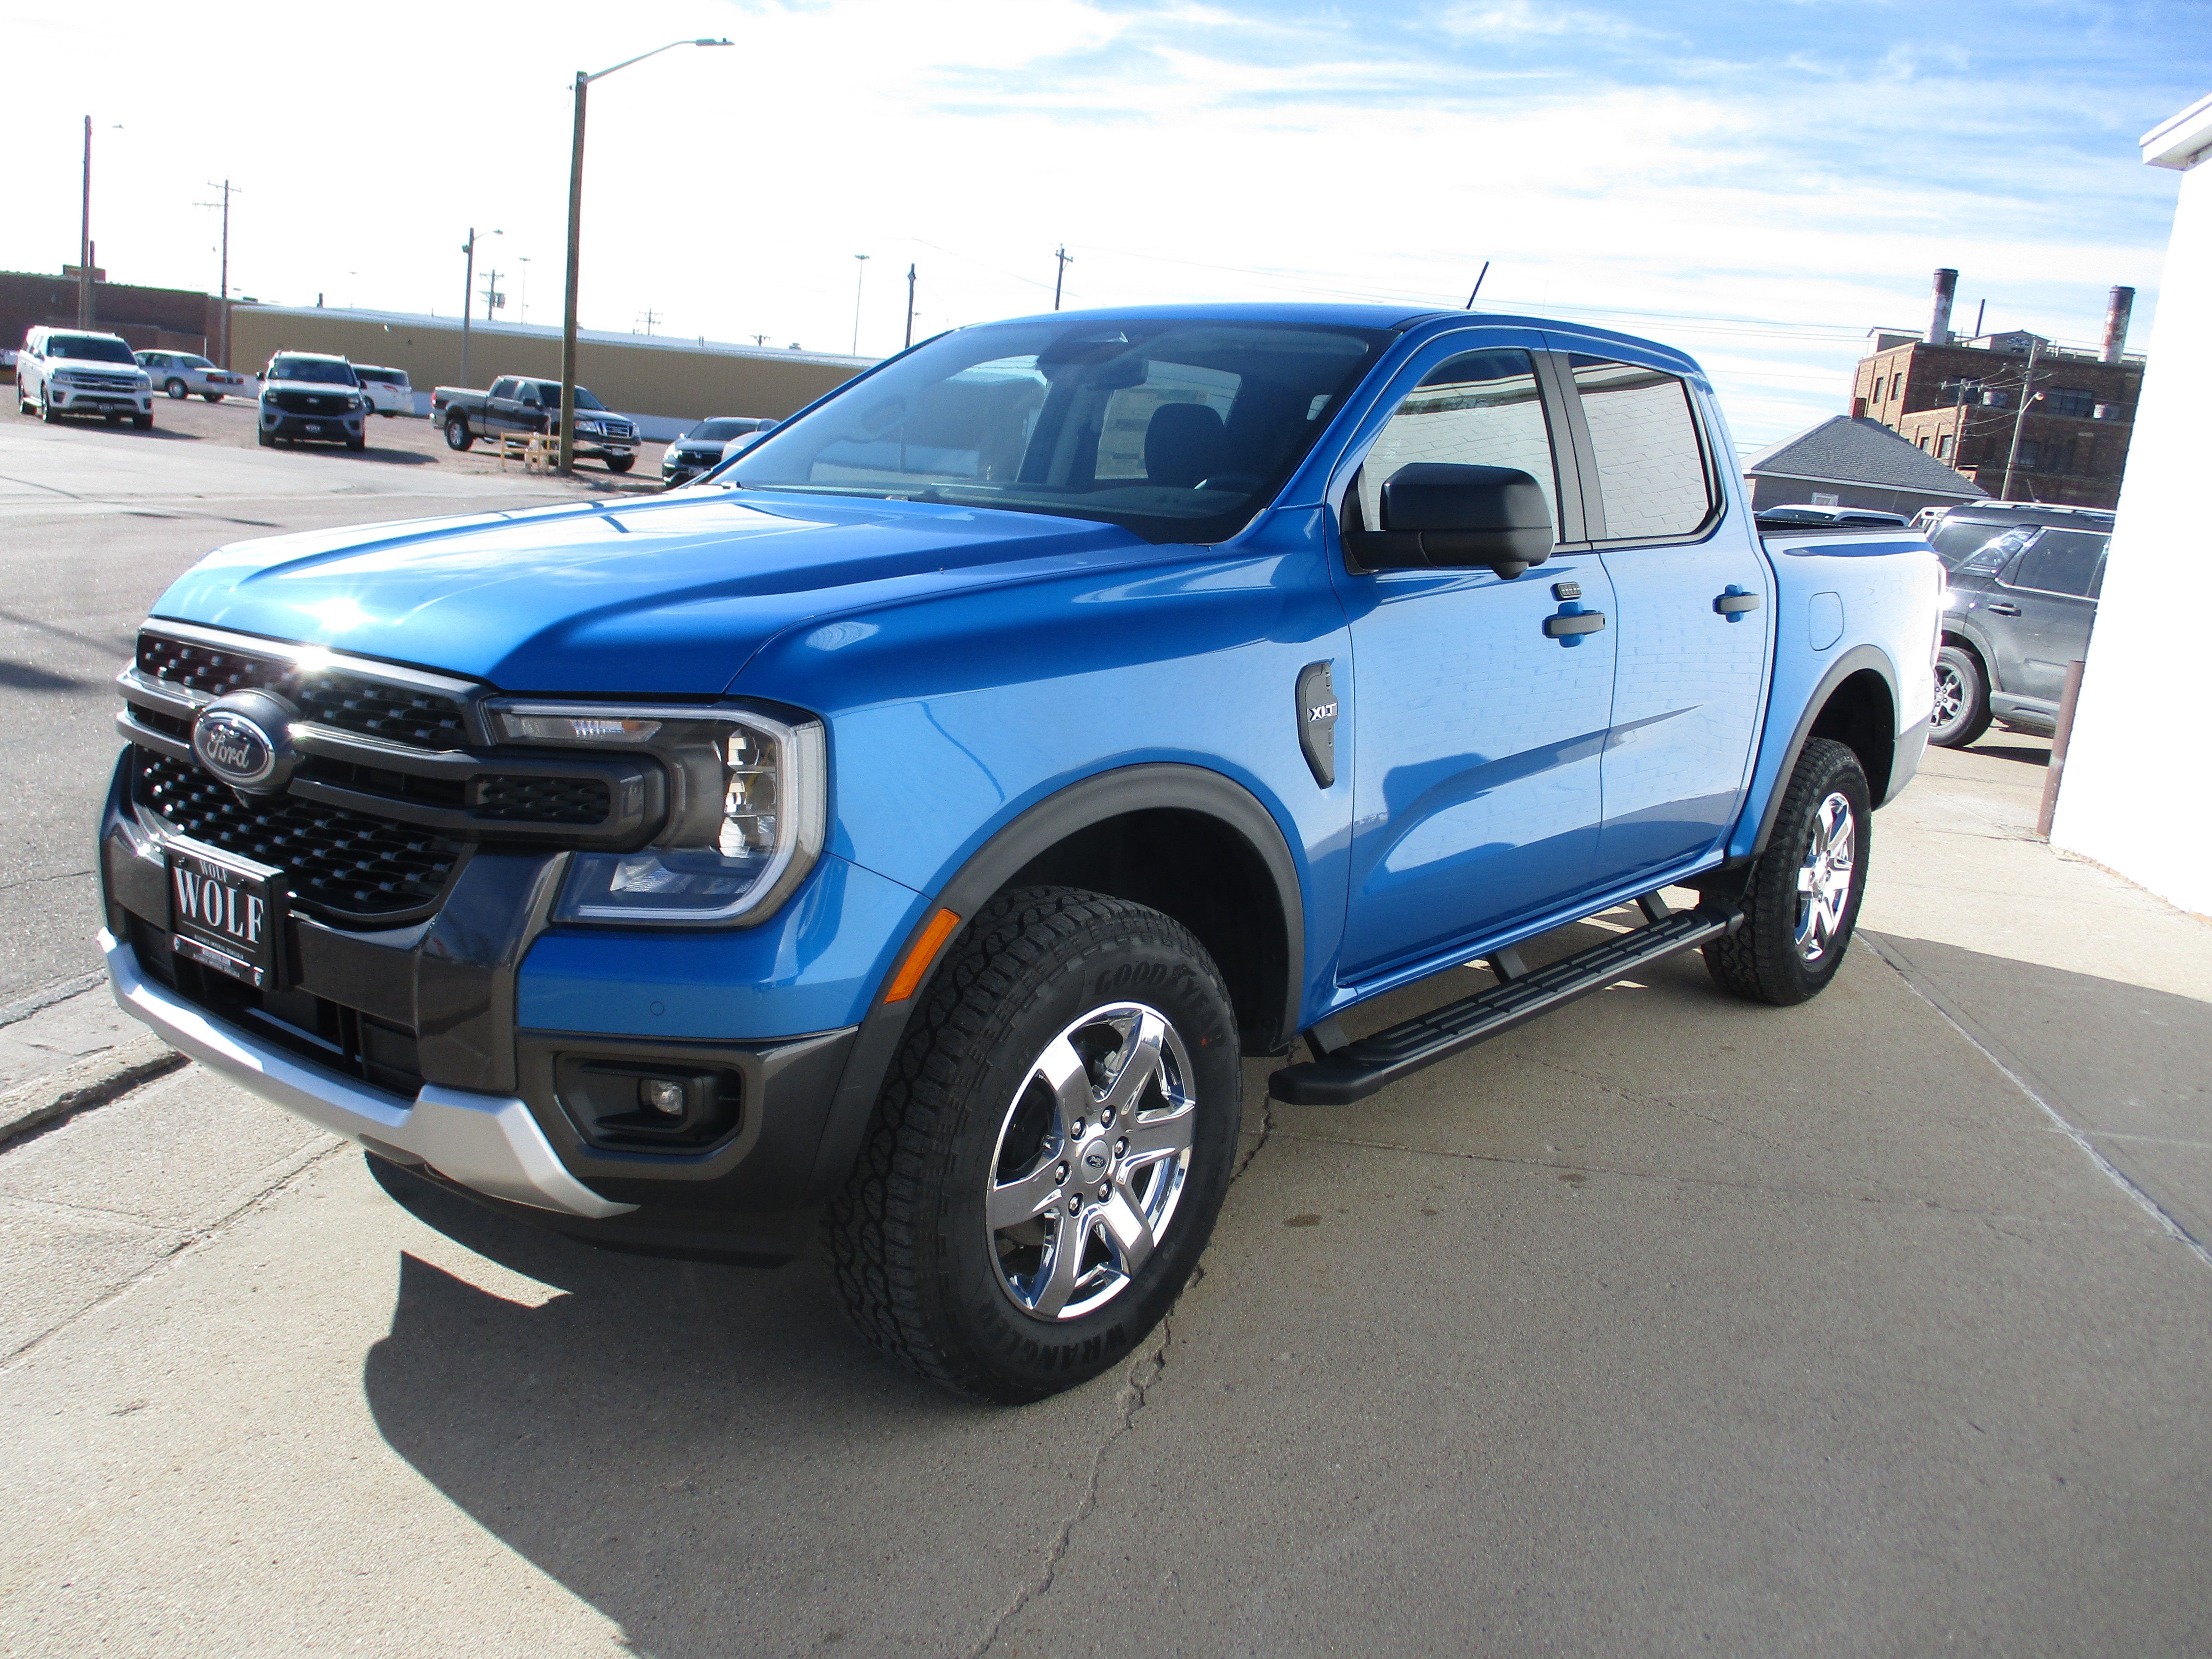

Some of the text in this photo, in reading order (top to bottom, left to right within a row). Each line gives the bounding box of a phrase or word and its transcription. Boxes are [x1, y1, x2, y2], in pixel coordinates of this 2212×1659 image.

[1310, 702, 1337, 720] XLT
[207, 726, 250, 769] Ford
[199, 859, 228, 883] WOLF
[173, 866, 264, 944] WOLF
[1094, 961, 1226, 1048] GOODYEAR
[1089, 1156, 1104, 1168] Ford
